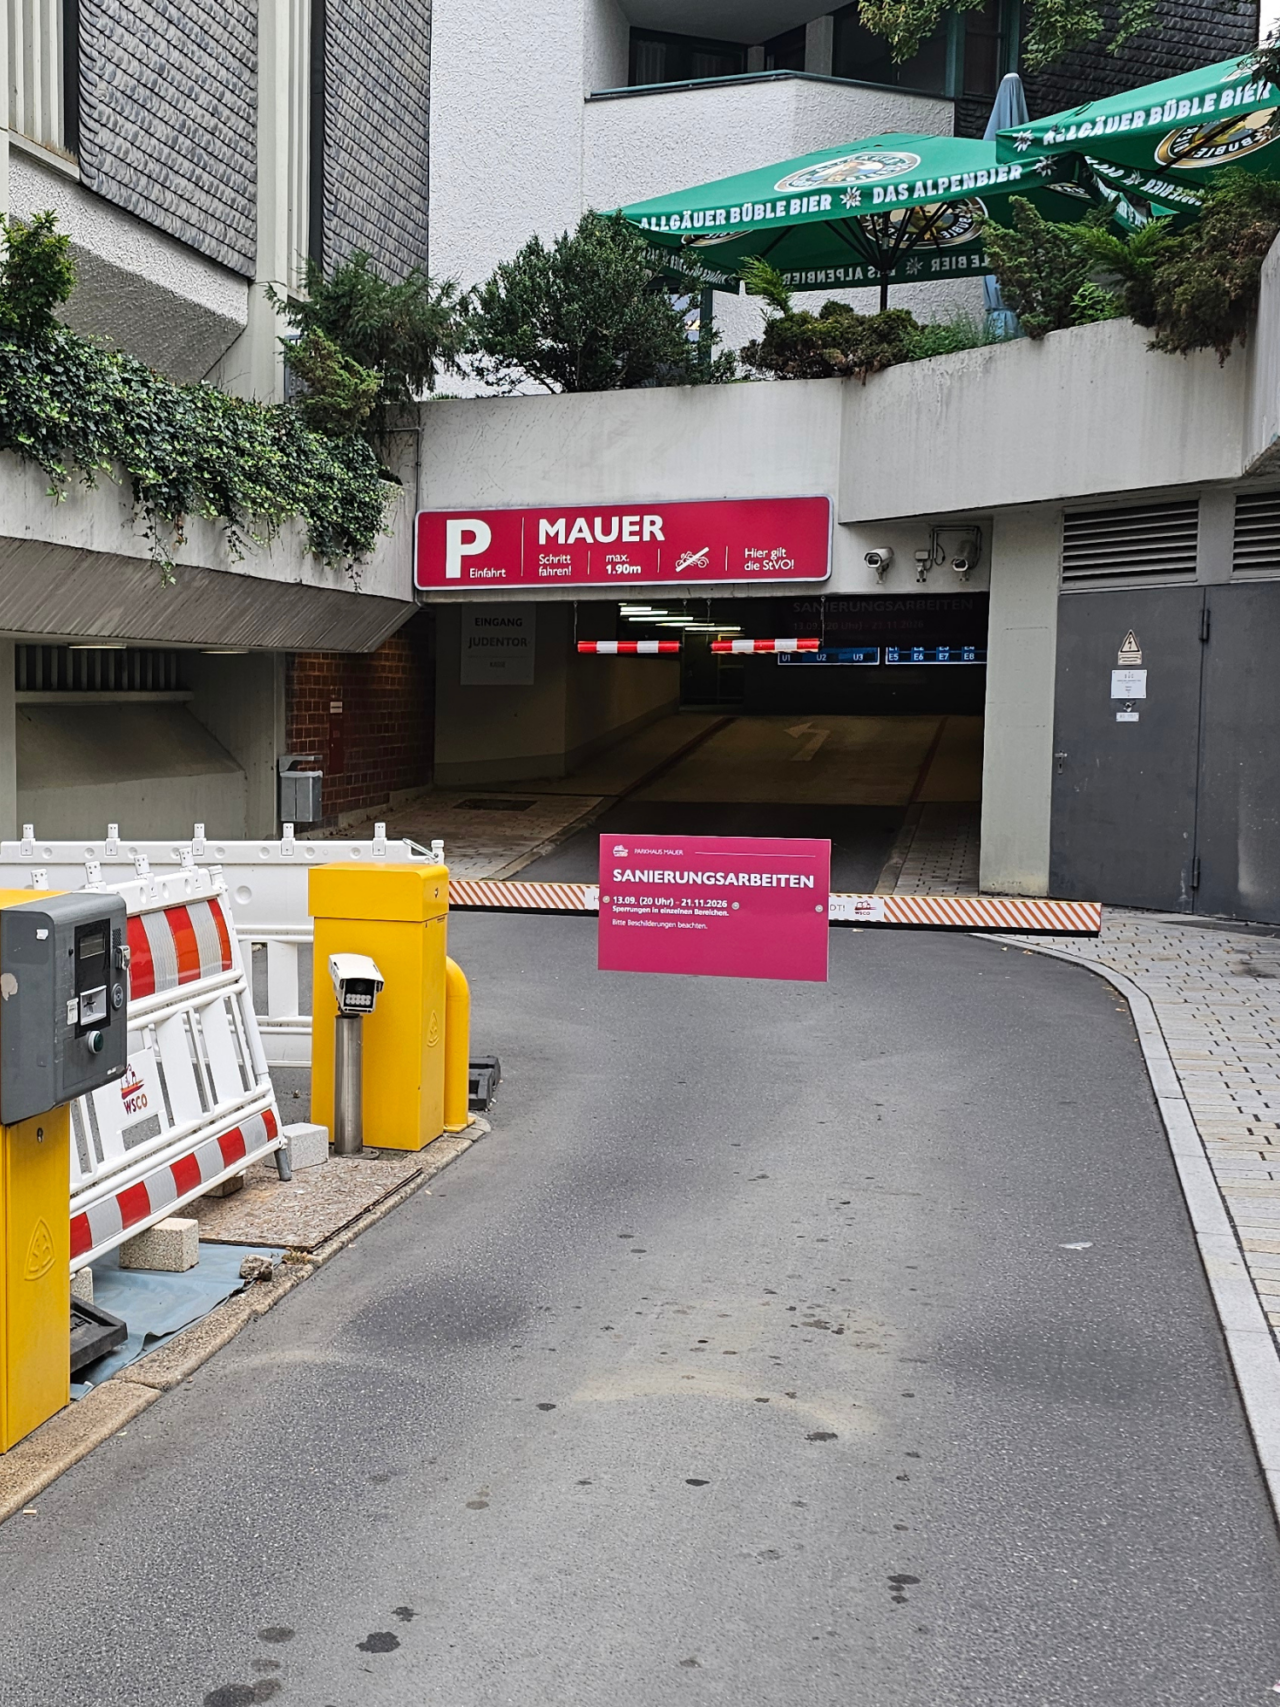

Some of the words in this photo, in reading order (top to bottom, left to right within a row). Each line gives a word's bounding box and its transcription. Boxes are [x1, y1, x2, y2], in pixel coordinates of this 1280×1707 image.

[1148, 92, 1218, 126] BÜBLE
[1220, 79, 1271, 110] BIER
[873, 183, 909, 204] DAS
[913, 164, 1023, 199] ALPENBIER
[639, 210, 727, 232] ALLGÄUER
[729, 201, 787, 224] BÜBLE
[789, 194, 833, 216] BIER
[538, 515, 666, 545] MAUER
[445, 518, 492, 579] P
[744, 548, 768, 558] Hier
[770, 546, 786, 561] gilt
[538, 554, 571, 564] Schritt
[606, 554, 629, 562] max.
[538, 566, 572, 577] fahren!
[606, 564, 642, 574] 1.90m
[744, 561, 760, 571] die
[762, 559, 795, 570] StVO!
[470, 568, 506, 578] Einfahrt
[793, 598, 974, 614] SANIERUNGSARBEITEN
[474, 617, 523, 628] EINGANG
[468, 636, 528, 650] JUDENTOR
[613, 868, 814, 889] SANIERUNGSARBEITEN
[613, 896, 638, 904] 13.09.
[639, 896, 653, 906] (20
[655, 898, 674, 906] Uhr)
[681, 898, 728, 908] 21.11.2026
[612, 905, 651, 914] Sperrungen
[627, 920, 676, 929] Beschilderungen
[123, 1093, 148, 1115] WSCO
